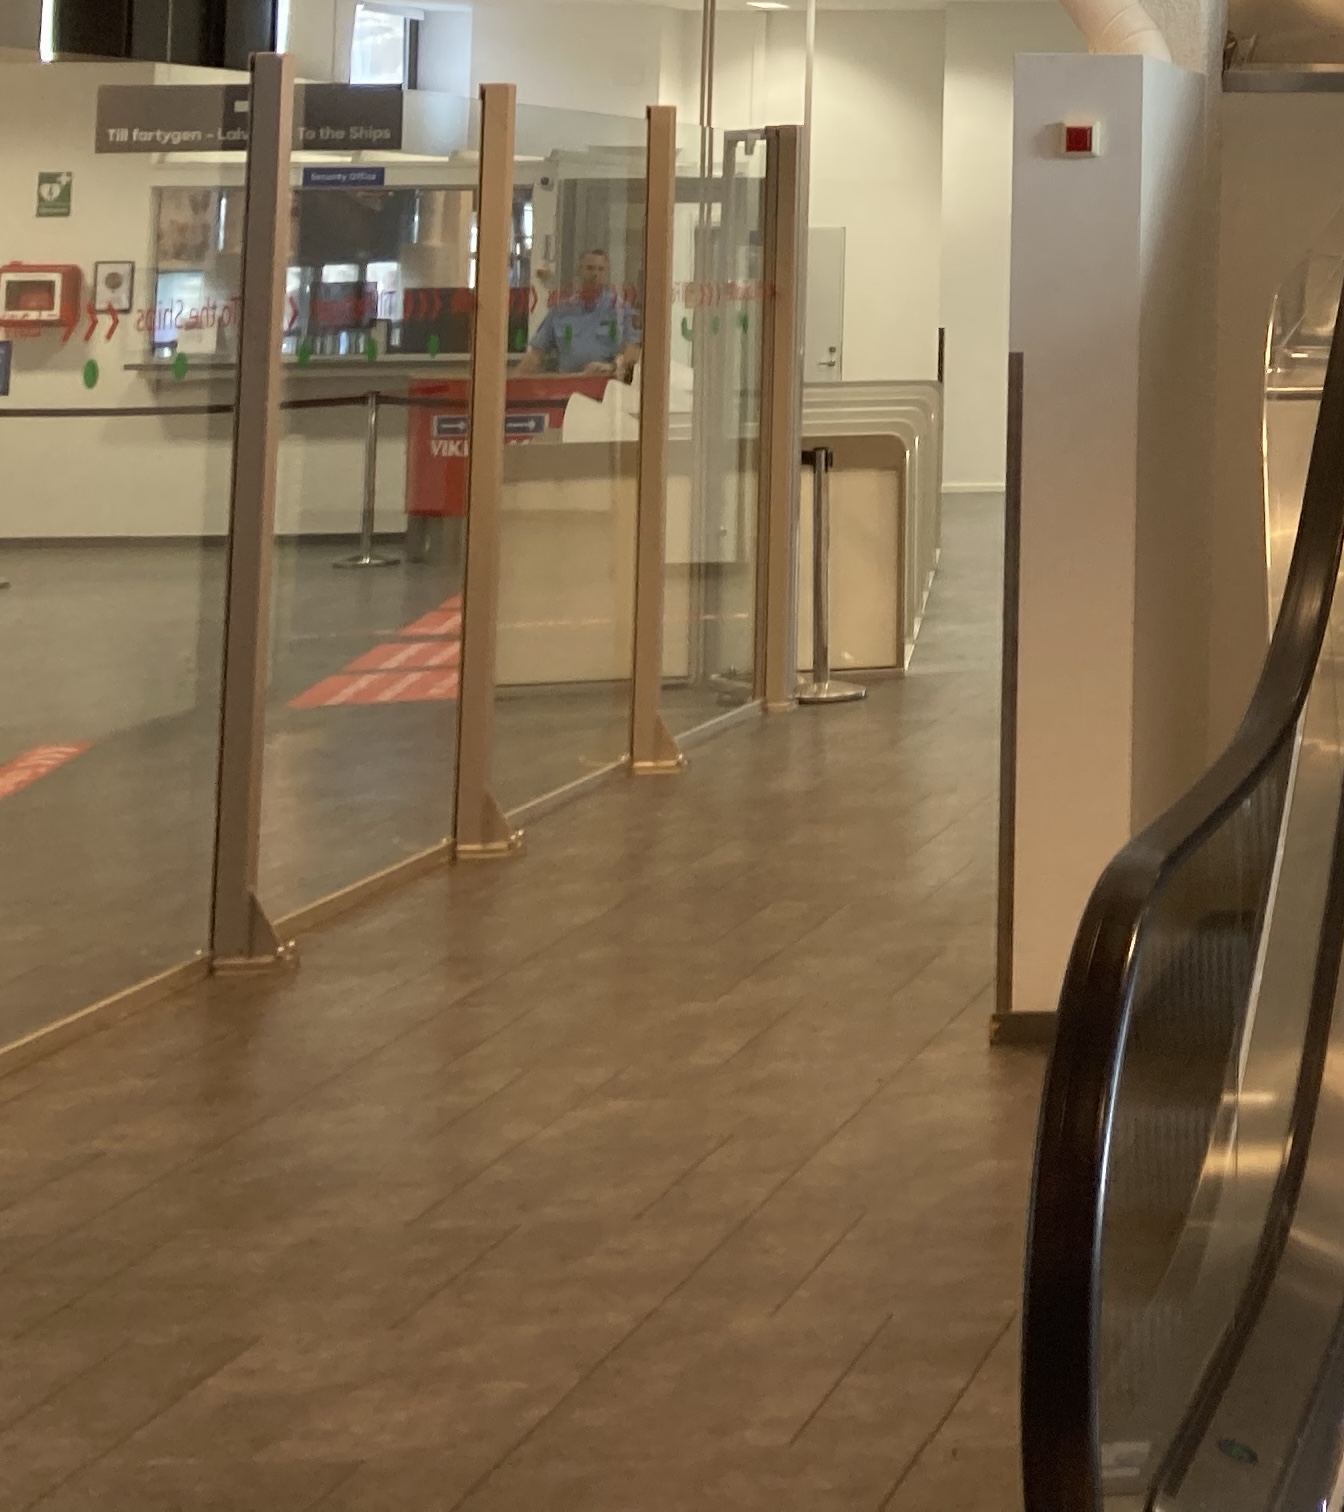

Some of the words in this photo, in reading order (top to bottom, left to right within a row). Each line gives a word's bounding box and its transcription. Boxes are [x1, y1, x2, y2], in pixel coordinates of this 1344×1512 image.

[108, 128, 128, 141] Till
[133, 127, 202, 144] fartygen
[298, 127, 316, 140] To
[319, 126, 345, 139] the
[349, 125, 391, 141] Ships
